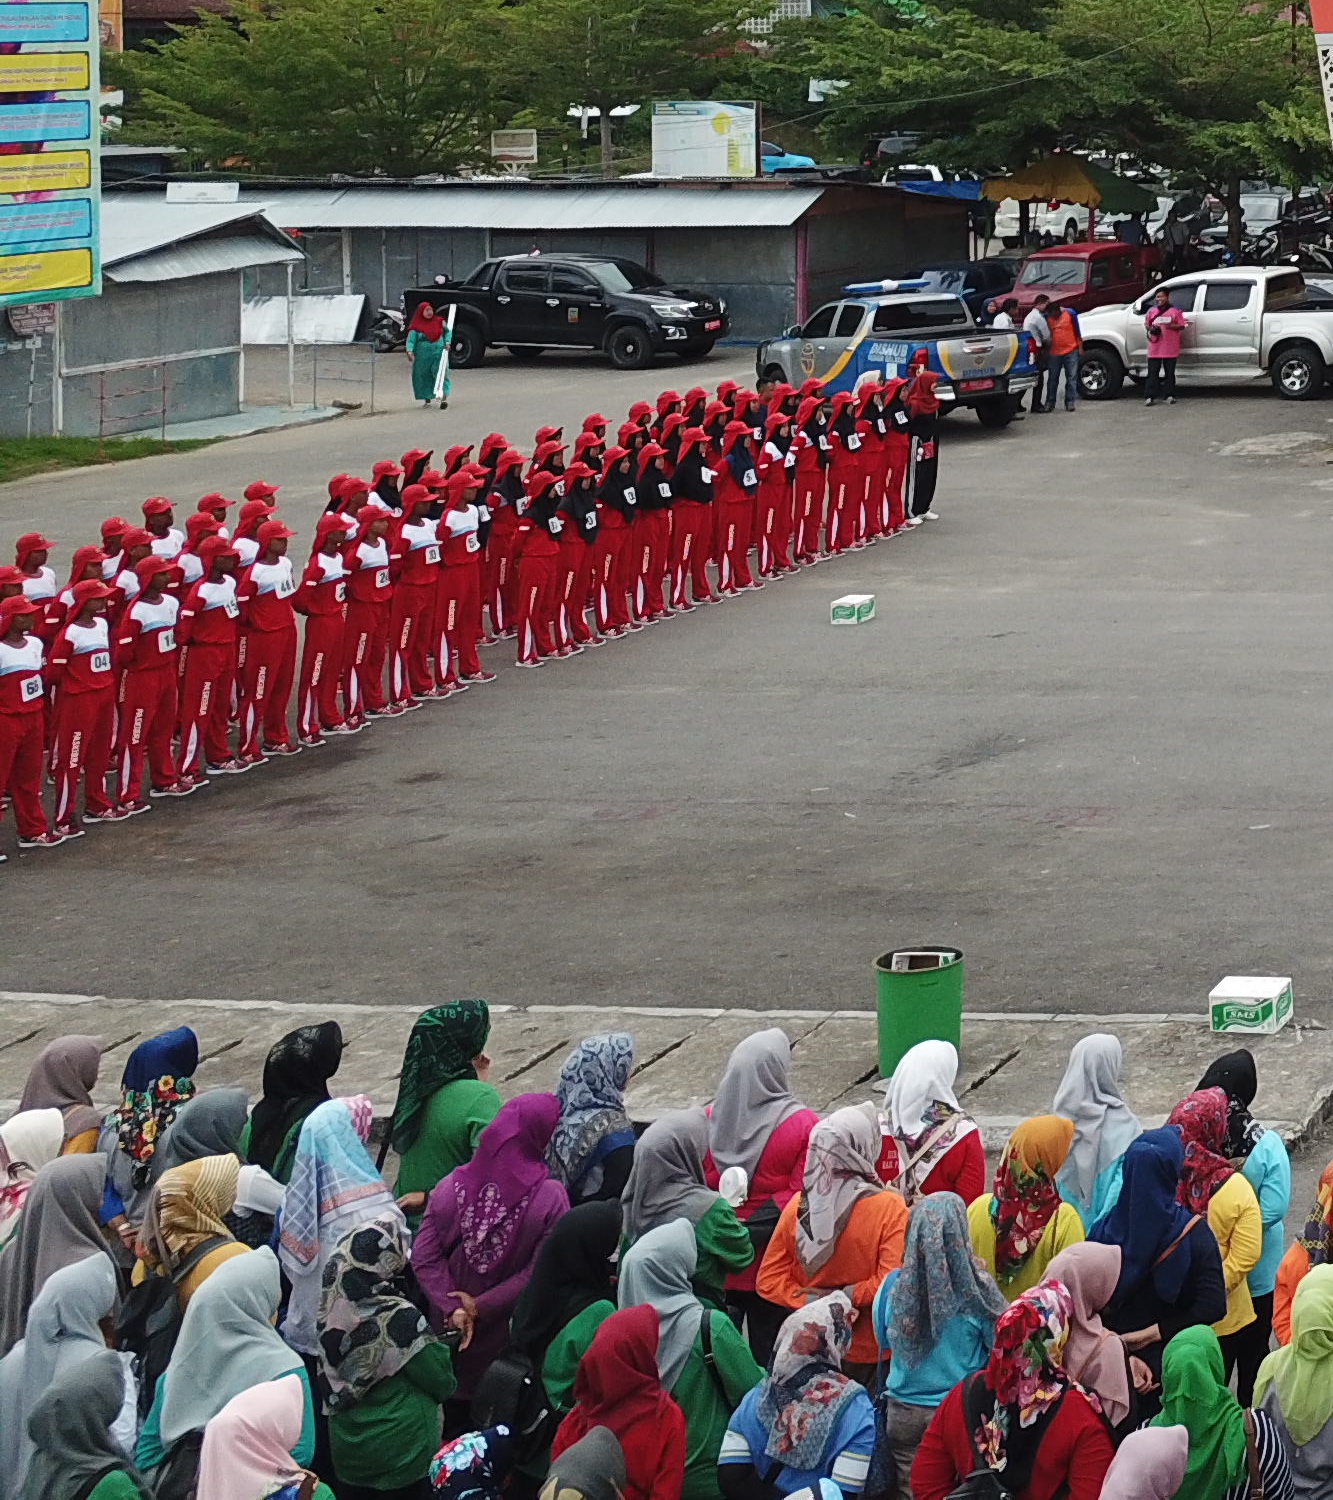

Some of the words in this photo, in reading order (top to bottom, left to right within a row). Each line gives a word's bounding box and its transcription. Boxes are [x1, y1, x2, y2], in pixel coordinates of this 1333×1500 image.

[870, 342, 909, 357] DISHUB
[95, 655, 107, 669] 04
[1230, 1011, 1256, 1019] SMS
